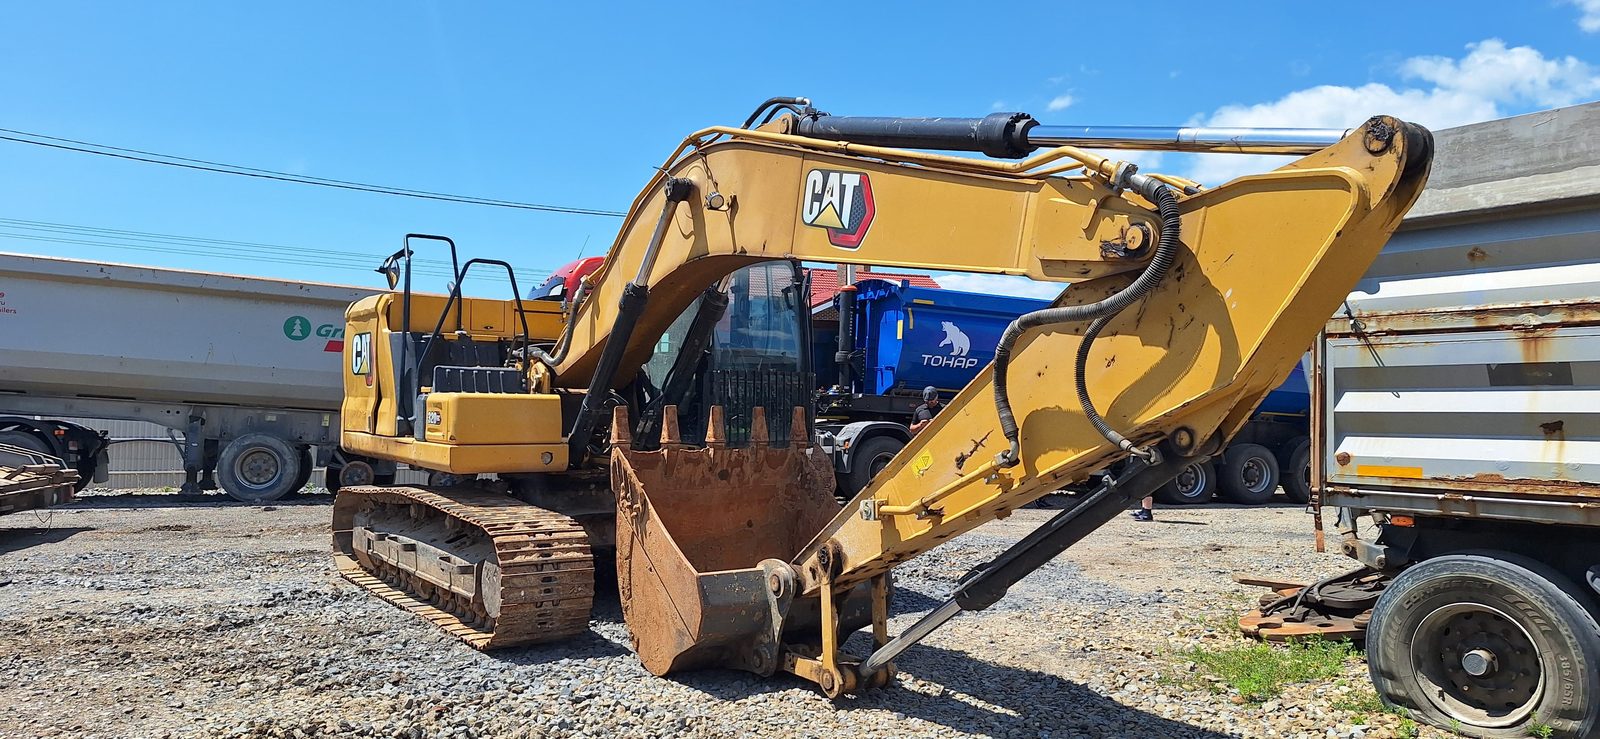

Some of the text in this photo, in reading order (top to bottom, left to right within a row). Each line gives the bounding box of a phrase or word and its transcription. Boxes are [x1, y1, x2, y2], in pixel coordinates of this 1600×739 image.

[803, 170, 861, 229] CAT
[352, 333, 371, 374] CAT
[921, 354, 978, 369] ТОНАР
